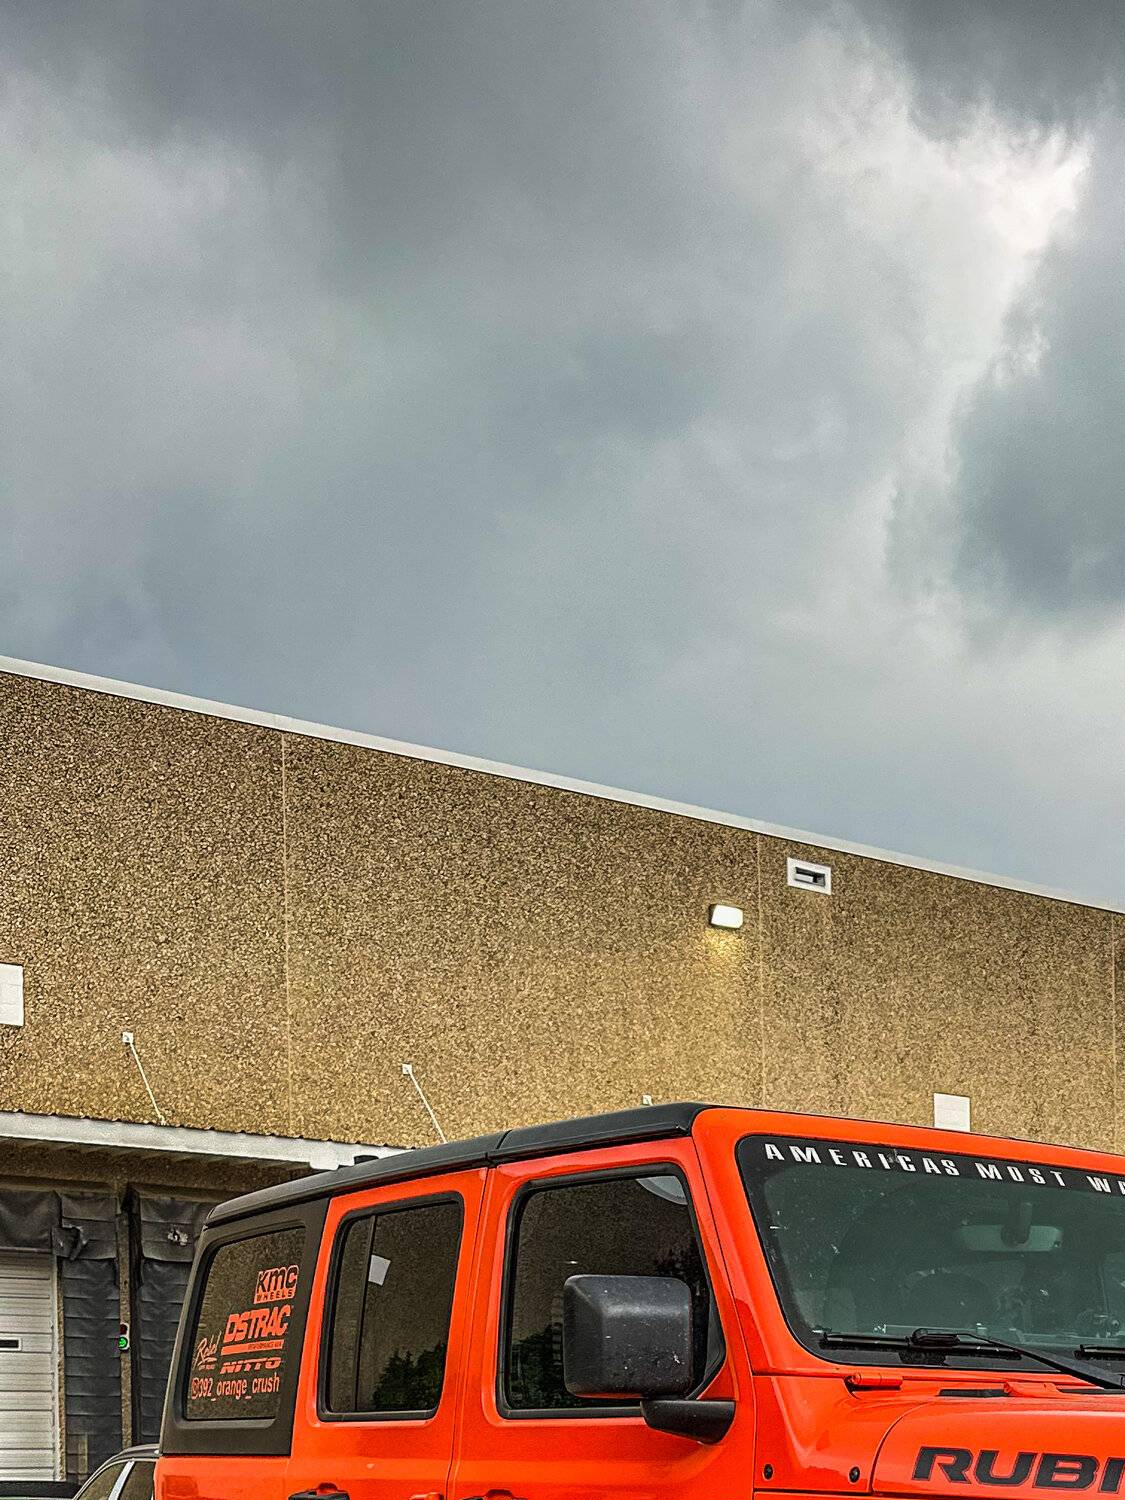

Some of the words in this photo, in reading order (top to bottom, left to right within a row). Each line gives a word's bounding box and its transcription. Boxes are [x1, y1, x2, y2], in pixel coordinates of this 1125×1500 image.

[764, 1143, 960, 1176] AMERICAS
[974, 1162, 1067, 1187] MOST
[256, 1289, 293, 1302] WHEELS
[220, 1356, 282, 1375] NITTO
